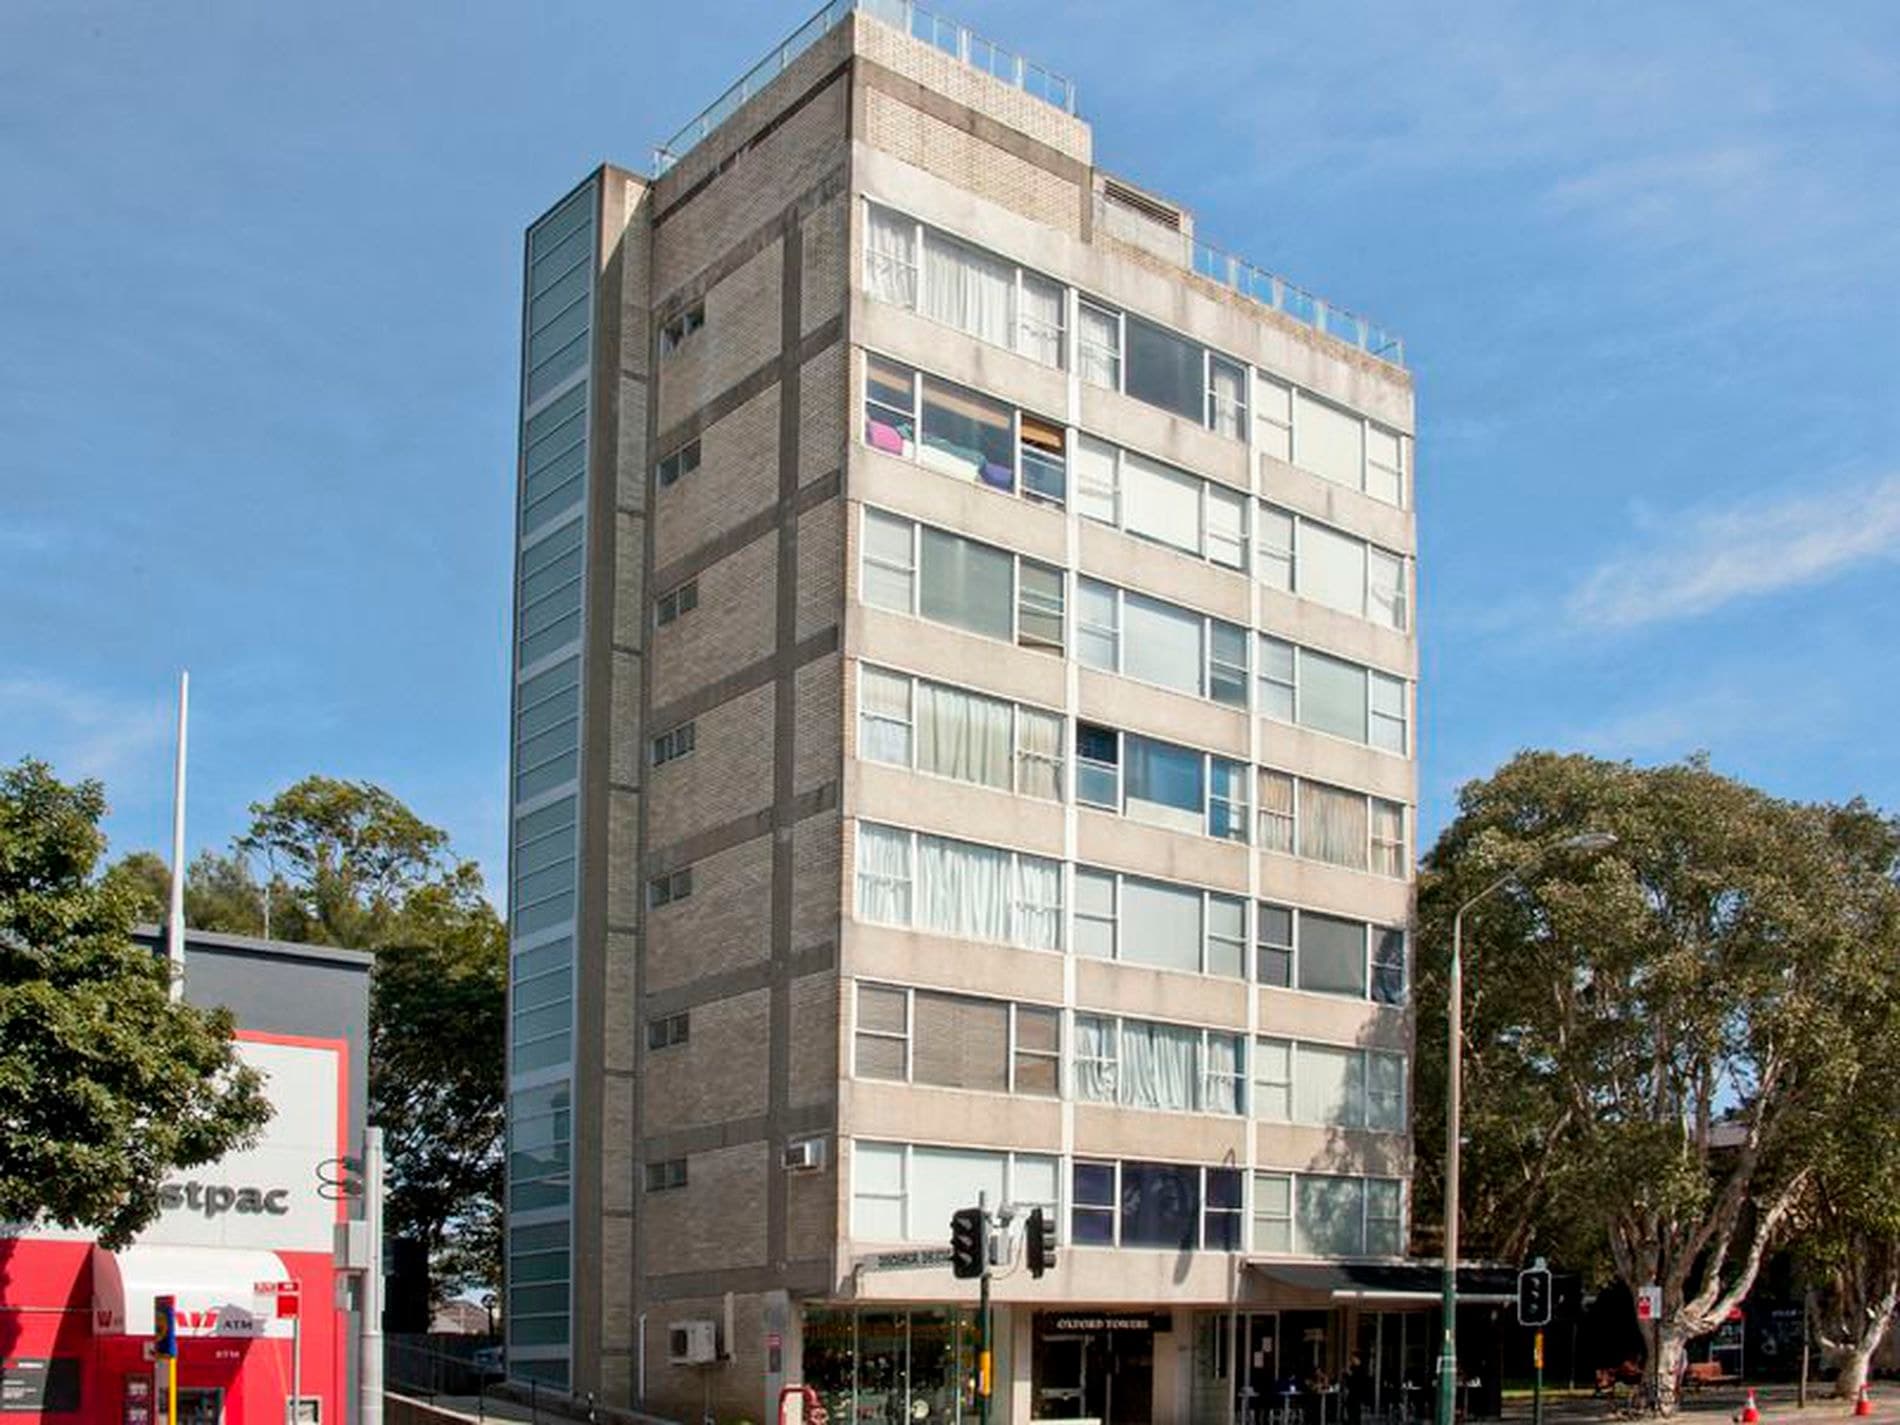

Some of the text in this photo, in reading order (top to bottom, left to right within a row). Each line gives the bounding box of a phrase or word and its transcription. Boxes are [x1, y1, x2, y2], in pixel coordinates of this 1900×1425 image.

[159, 1181, 289, 1218] stpac
[223, 1320, 253, 1330] ATM
[1056, 1319, 1104, 1329] OXFORD
